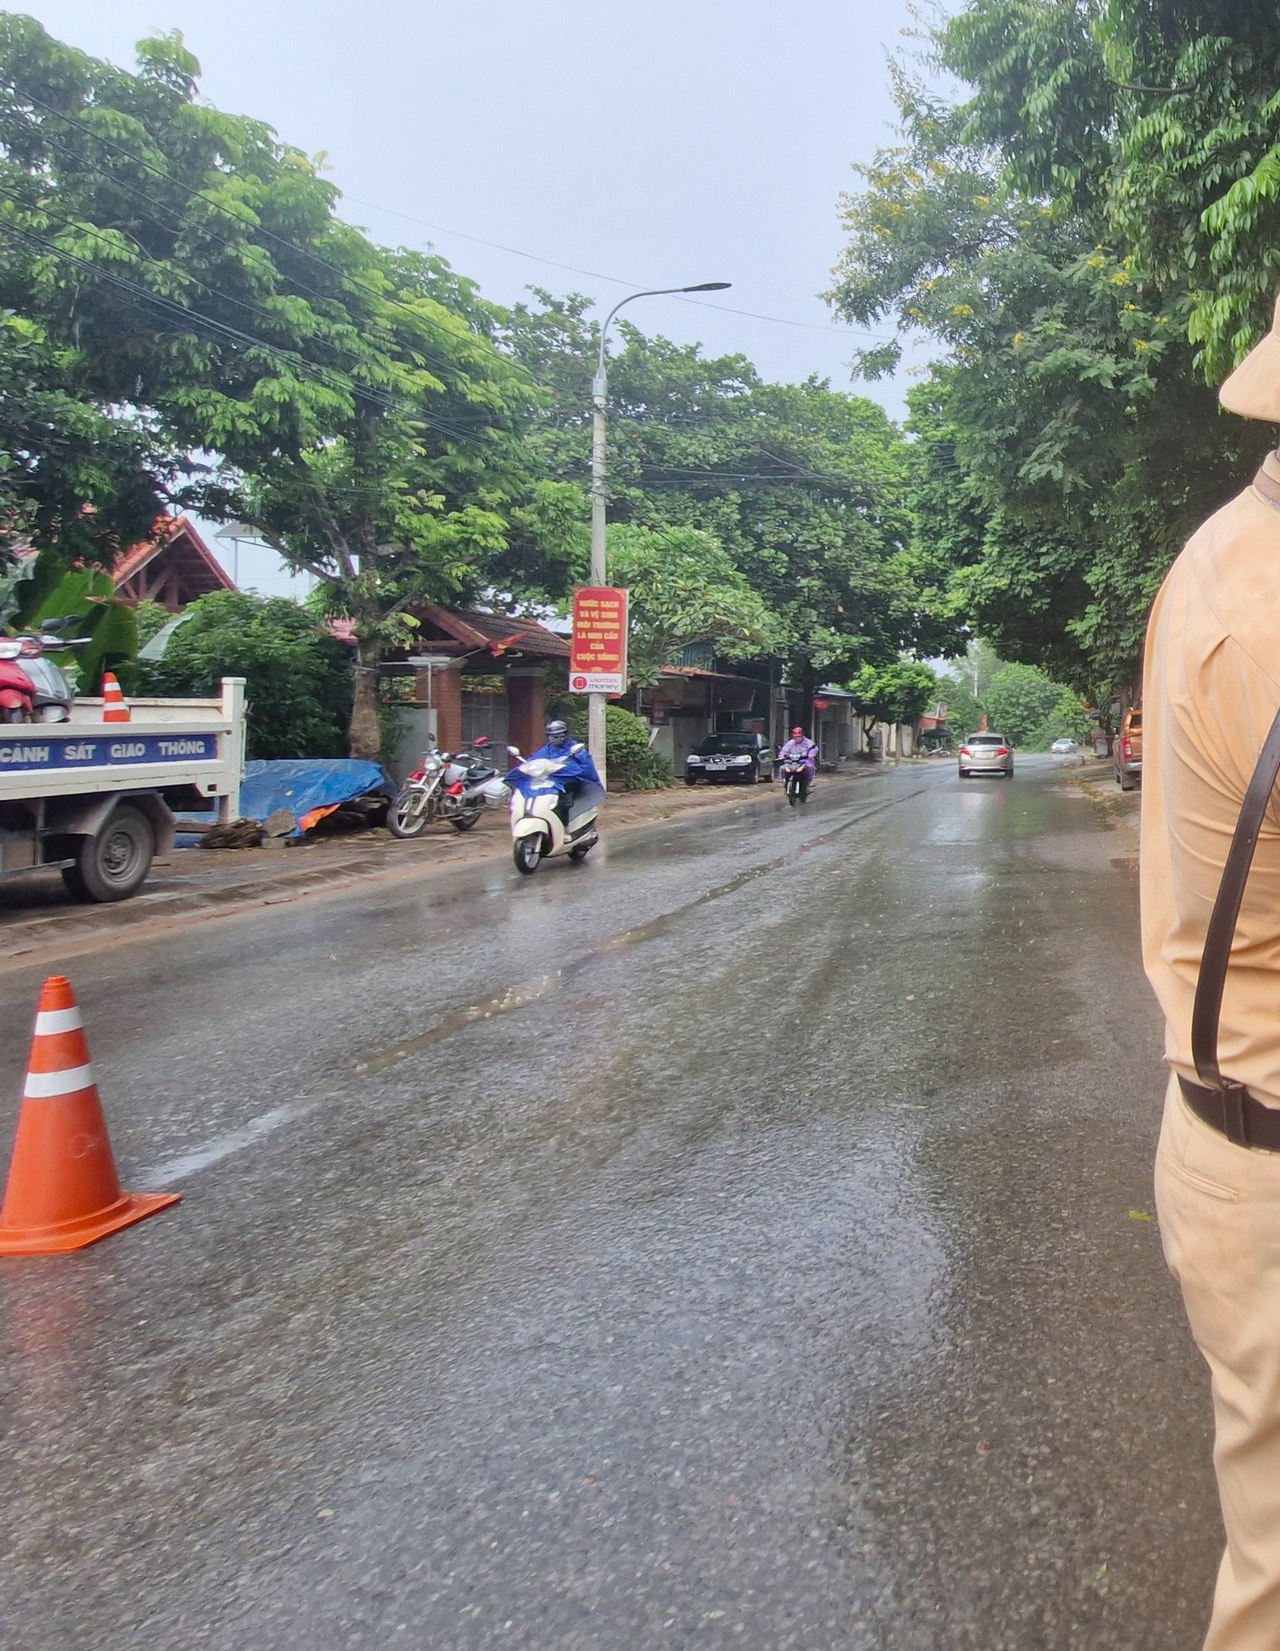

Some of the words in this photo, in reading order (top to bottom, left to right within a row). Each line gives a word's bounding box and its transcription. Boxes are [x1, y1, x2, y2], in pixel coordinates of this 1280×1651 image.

[600, 600, 619, 609] SẠCH
[590, 610, 600, 619] VỆ
[601, 611, 618, 619] SINH
[576, 652, 596, 662] CUỘC
[0, 742, 50, 764] CẢNH
[64, 741, 96, 761] SÁT
[110, 743, 146, 758] GIAO
[158, 739, 206, 756] THÔNG
